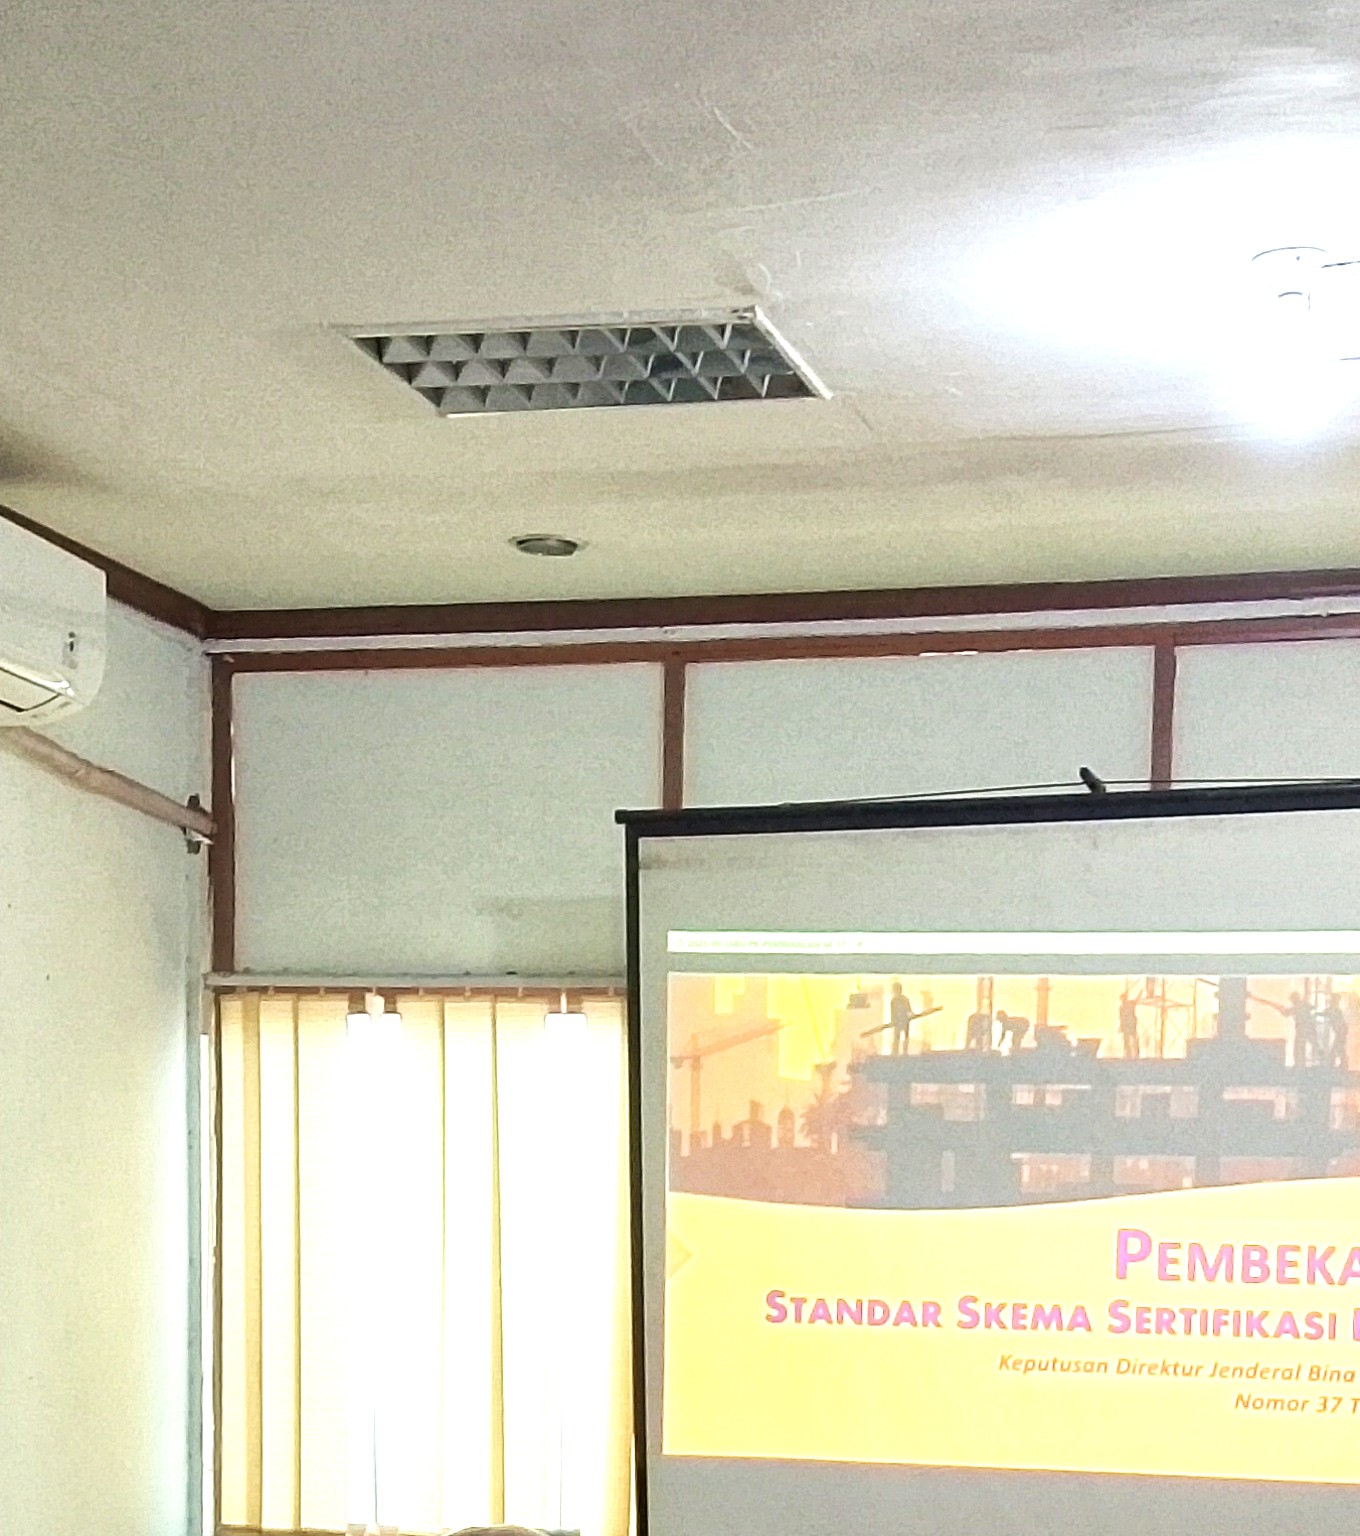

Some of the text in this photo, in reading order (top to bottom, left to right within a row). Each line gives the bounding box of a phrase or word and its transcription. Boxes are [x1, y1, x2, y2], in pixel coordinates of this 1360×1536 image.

[765, 1289, 943, 1328] STANDAR
[957, 1295, 1093, 1333] SKEMA
[1107, 1299, 1337, 1341] SERTIFIKASI
[998, 1354, 1108, 1375] Keputusan
[1116, 1358, 1204, 1378] Direktur
[1208, 1361, 1301, 1381] Jenderal
[1307, 1364, 1356, 1383] Bina
[1234, 1393, 1310, 1412] Nomor
[1315, 1396, 1343, 1413] 37
